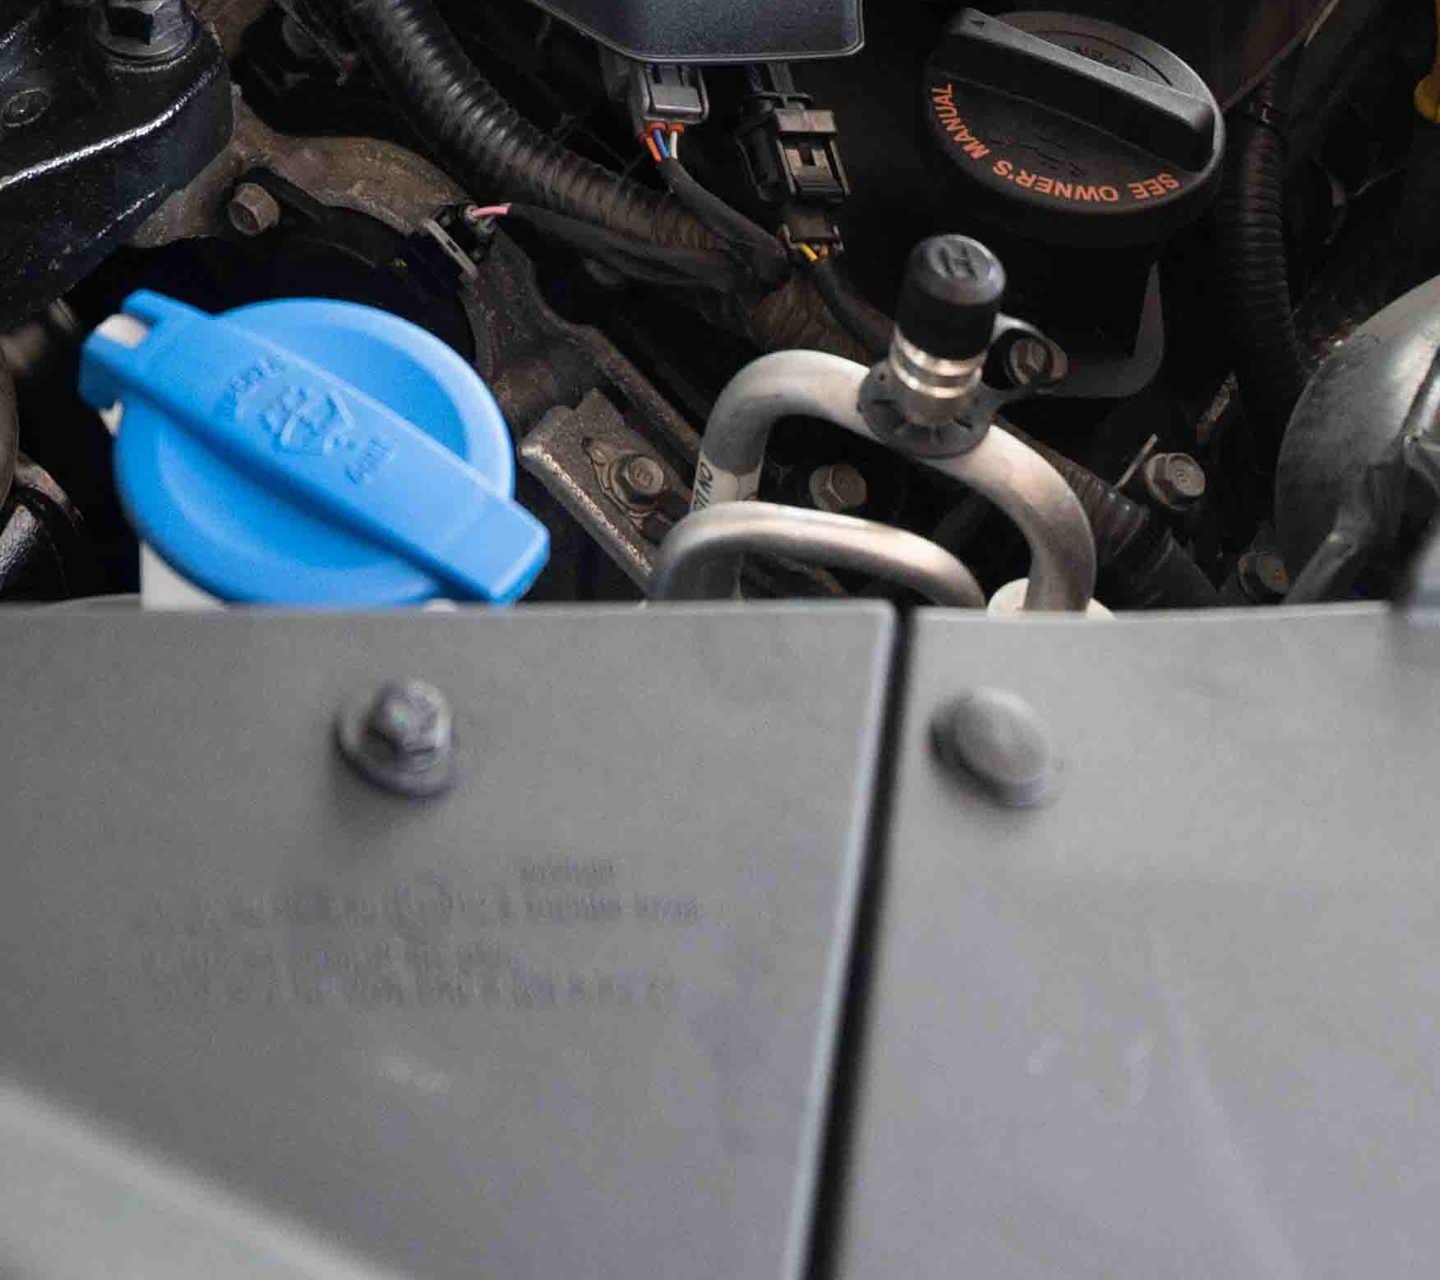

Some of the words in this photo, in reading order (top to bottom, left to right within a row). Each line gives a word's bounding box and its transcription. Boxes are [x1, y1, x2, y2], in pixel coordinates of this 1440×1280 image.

[931, 82, 991, 159] MANUAL
[991, 158, 1120, 204] OWNER'S
[1129, 172, 1180, 202] SEE
